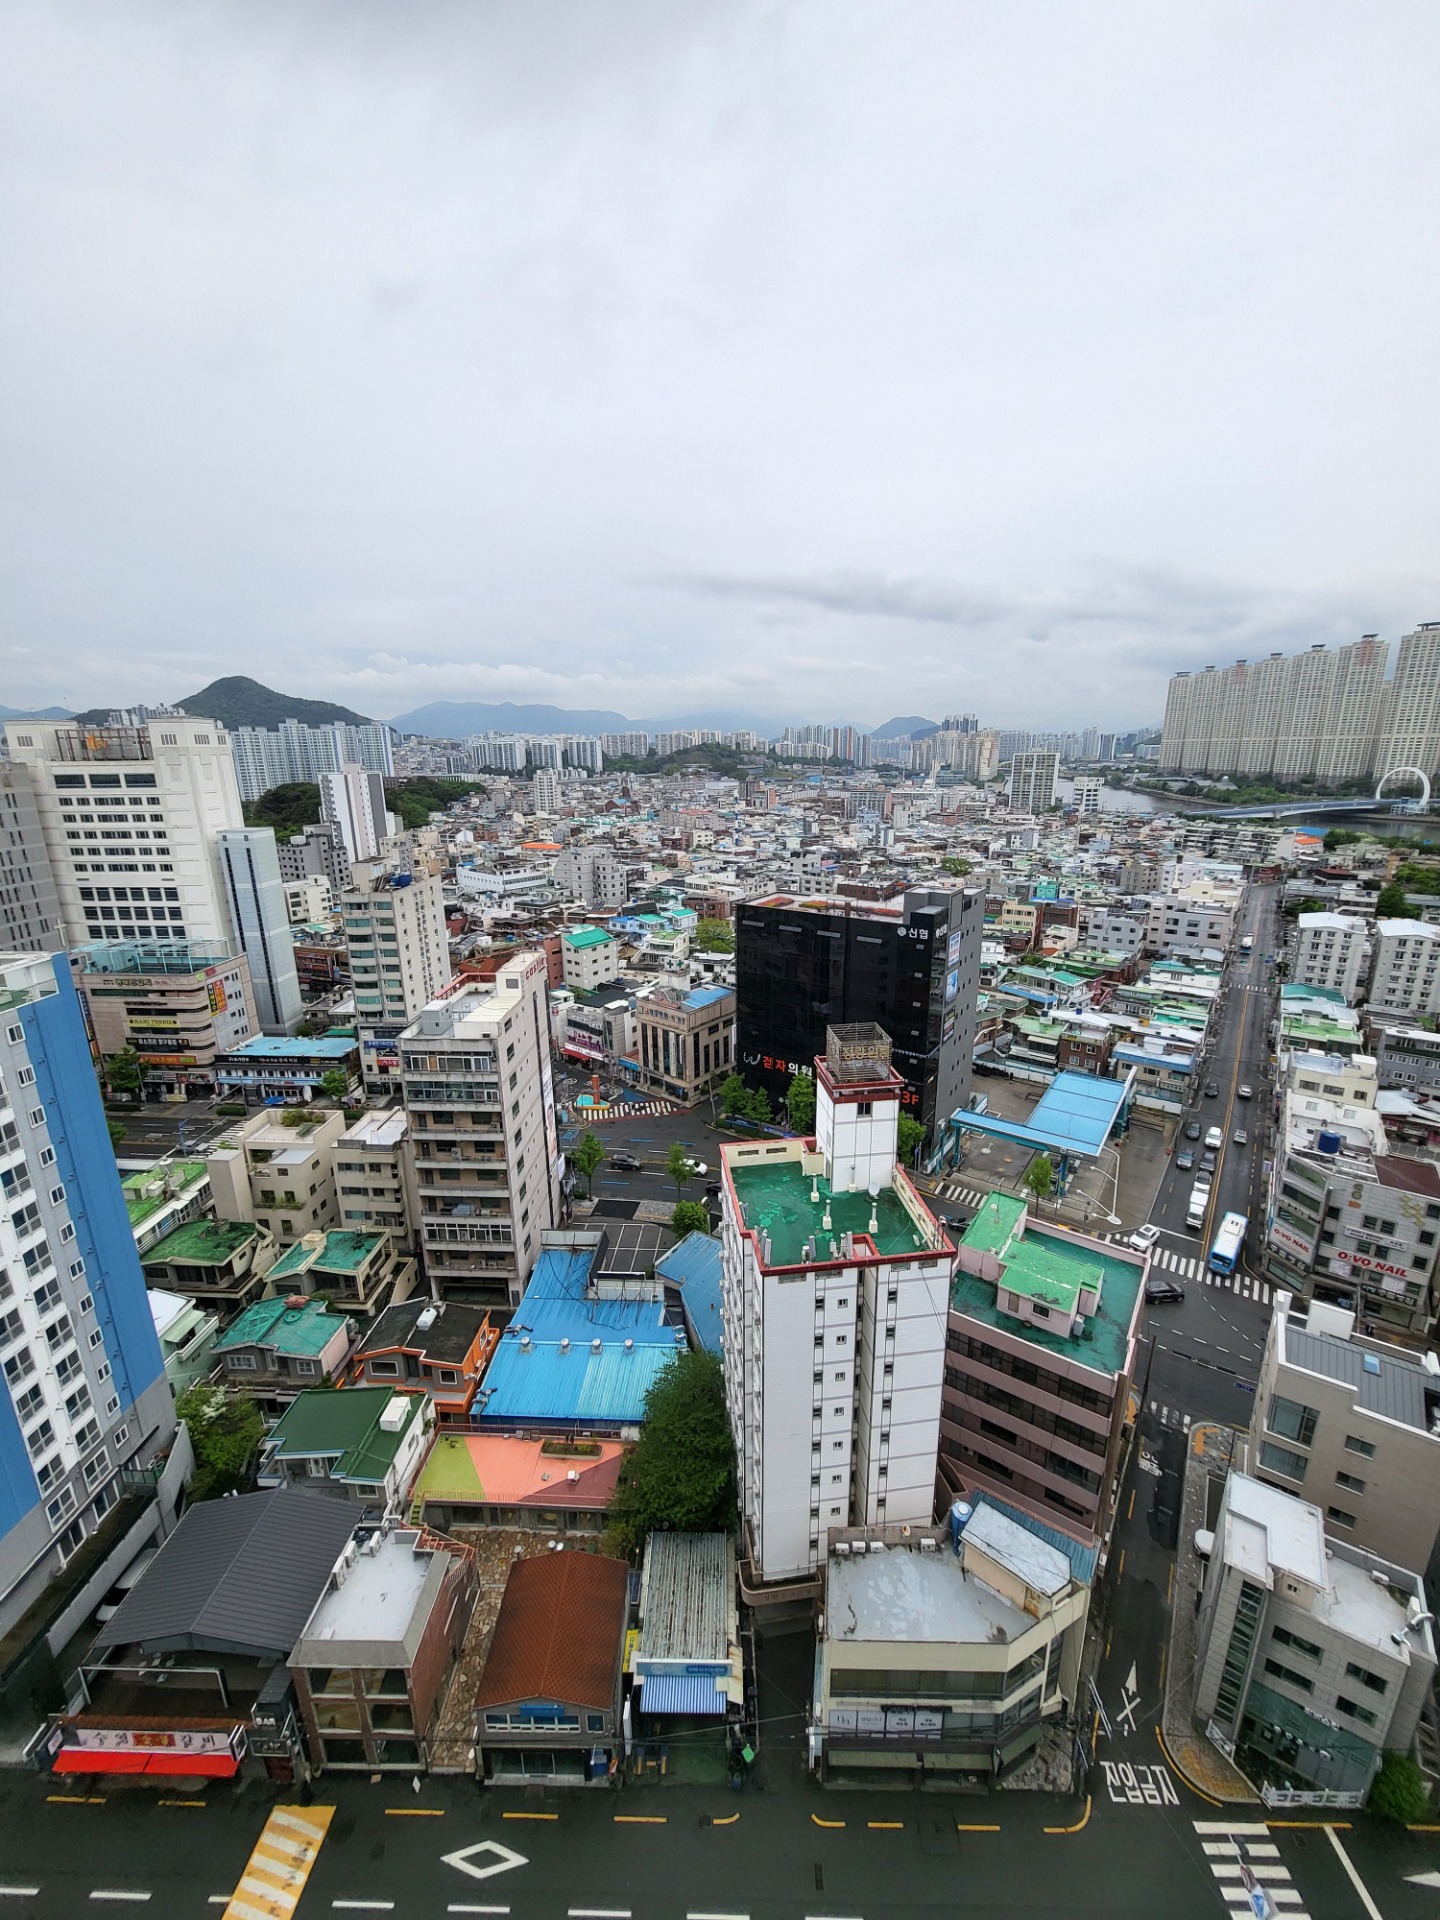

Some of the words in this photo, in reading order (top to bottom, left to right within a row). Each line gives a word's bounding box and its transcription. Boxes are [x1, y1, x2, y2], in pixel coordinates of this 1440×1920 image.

[909, 927, 928, 939] 신협
[901, 1090, 920, 1106] 3F
[1292, 1239, 1310, 1253] NAIL
[1375, 1262, 1407, 1277] NAIL
